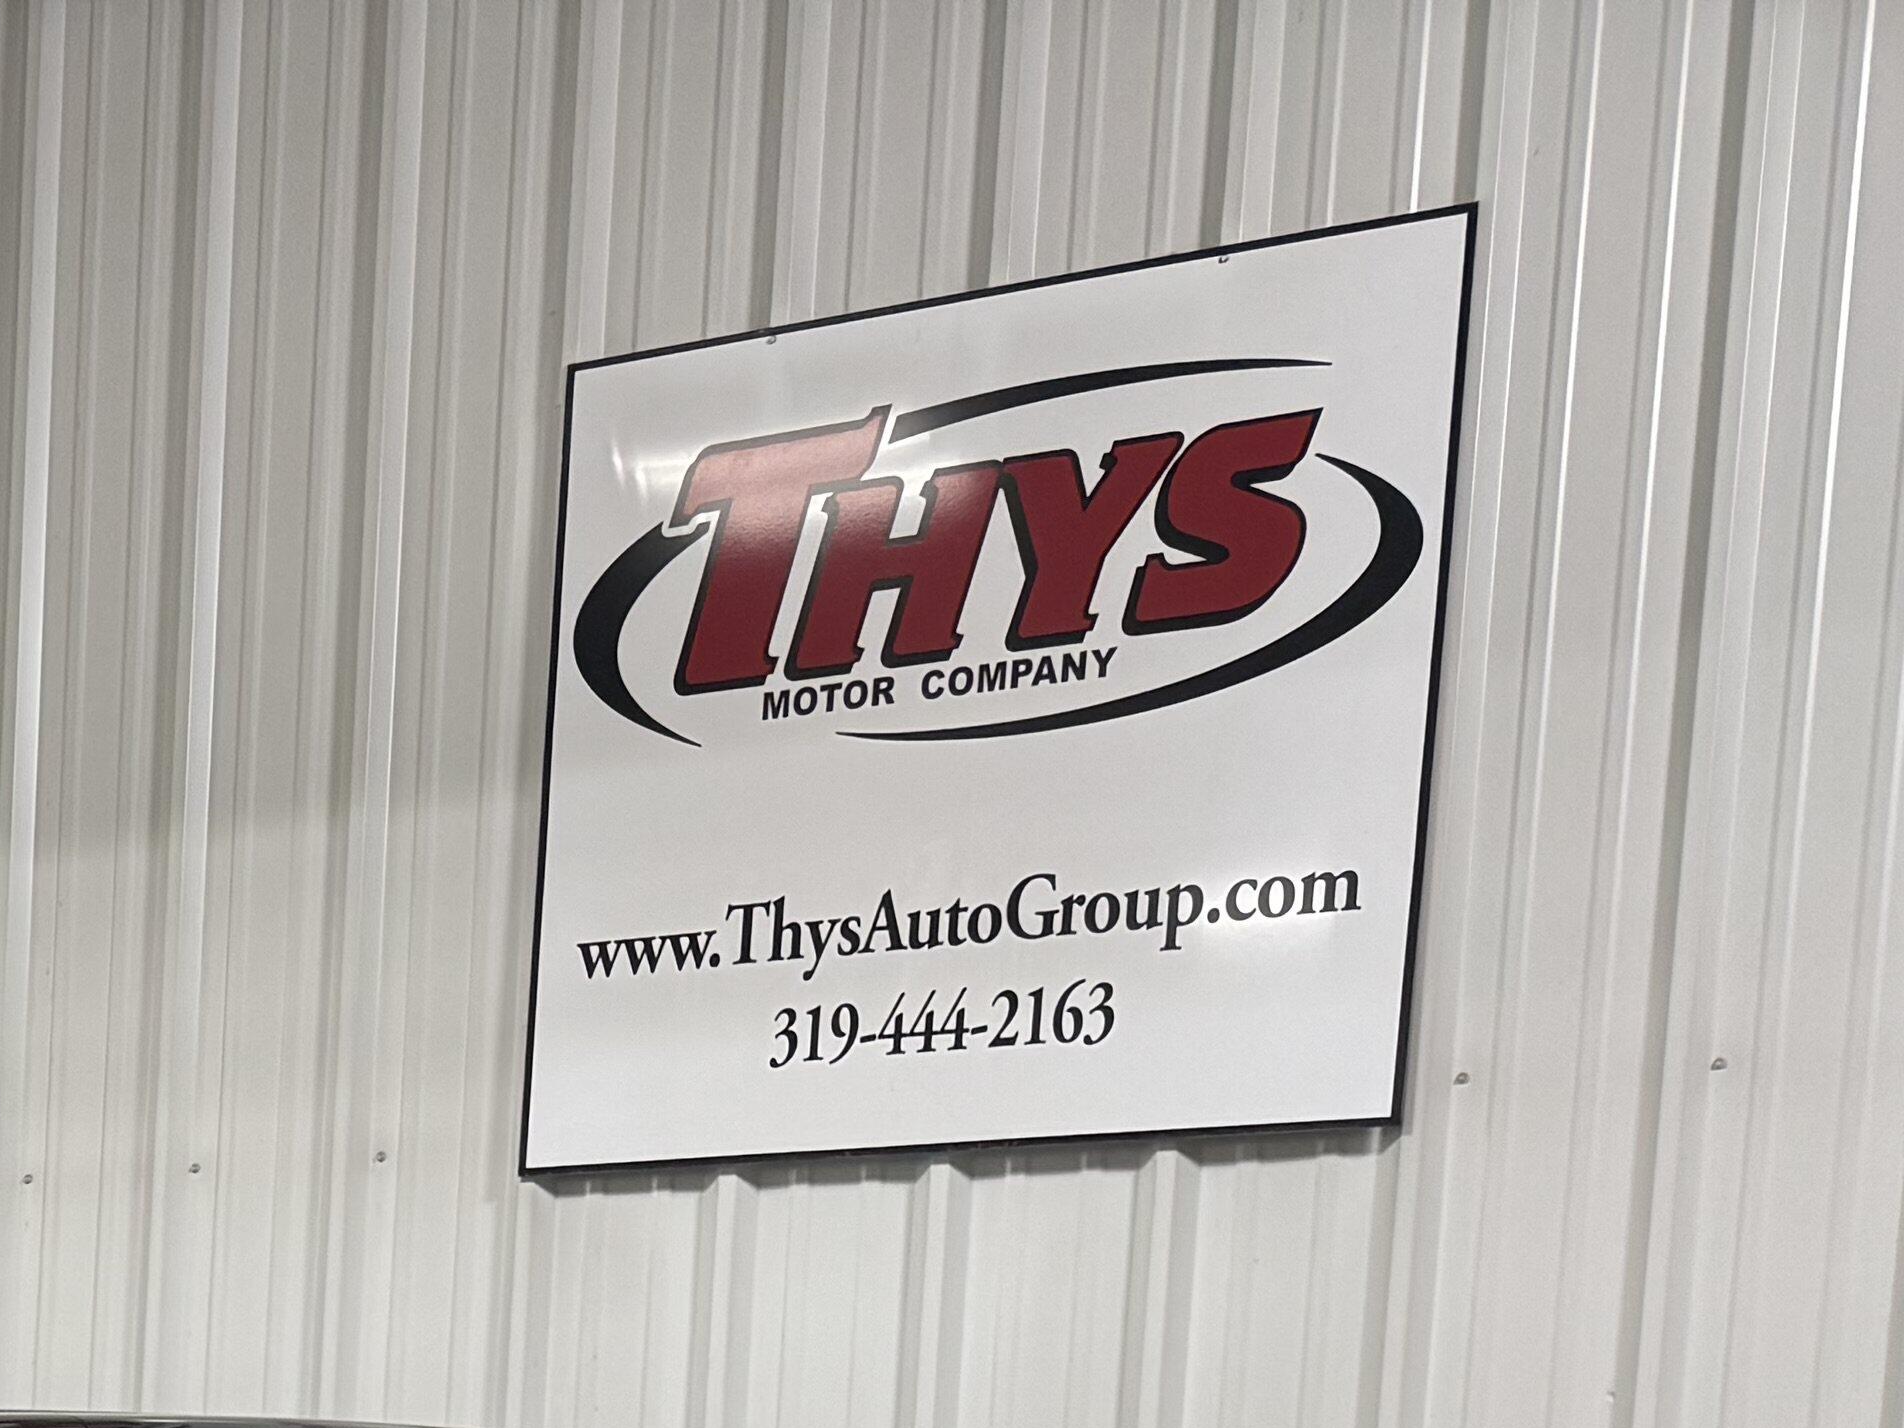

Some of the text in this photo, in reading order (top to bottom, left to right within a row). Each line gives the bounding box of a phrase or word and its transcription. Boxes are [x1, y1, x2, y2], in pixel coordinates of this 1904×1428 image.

[672, 404, 1324, 697] THYS
[761, 646, 1118, 722] MOTOR COMPANY
[577, 866, 1361, 981] www.ThysAutoGroup.com
[768, 979, 1116, 1069] 319-444-2163
